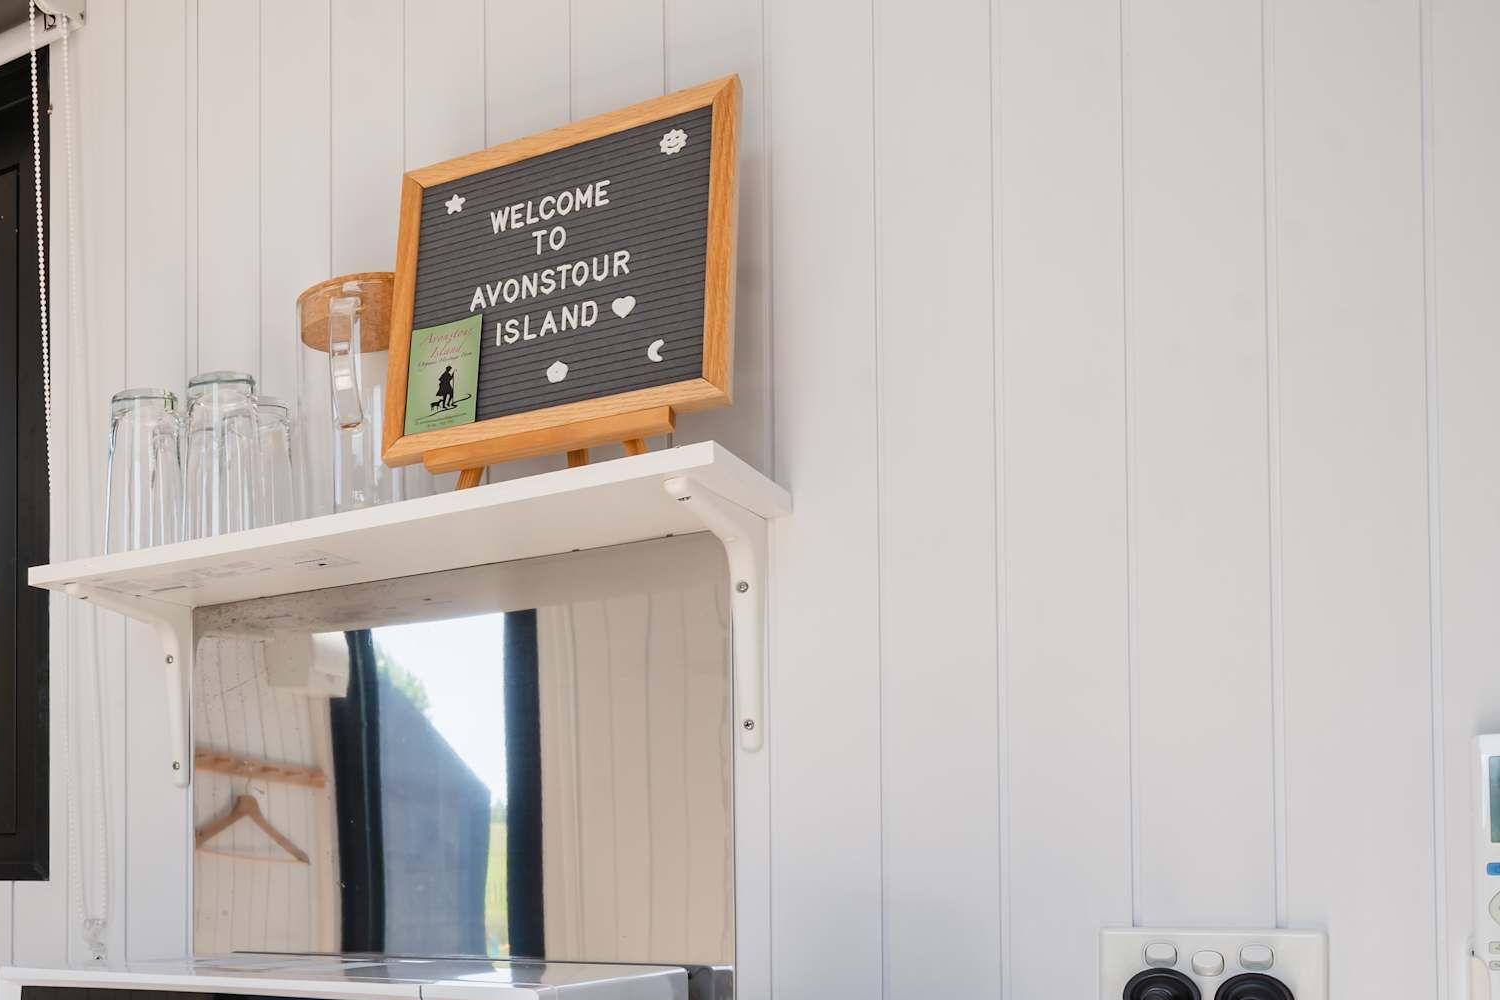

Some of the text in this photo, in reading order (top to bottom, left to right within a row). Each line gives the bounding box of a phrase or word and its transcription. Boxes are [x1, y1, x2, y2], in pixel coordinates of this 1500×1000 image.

[490, 179, 611, 234] WELCOME
[531, 225, 567, 256] TO
[469, 249, 631, 313] AVONSTOUR
[495, 300, 599, 347] ISLAND
